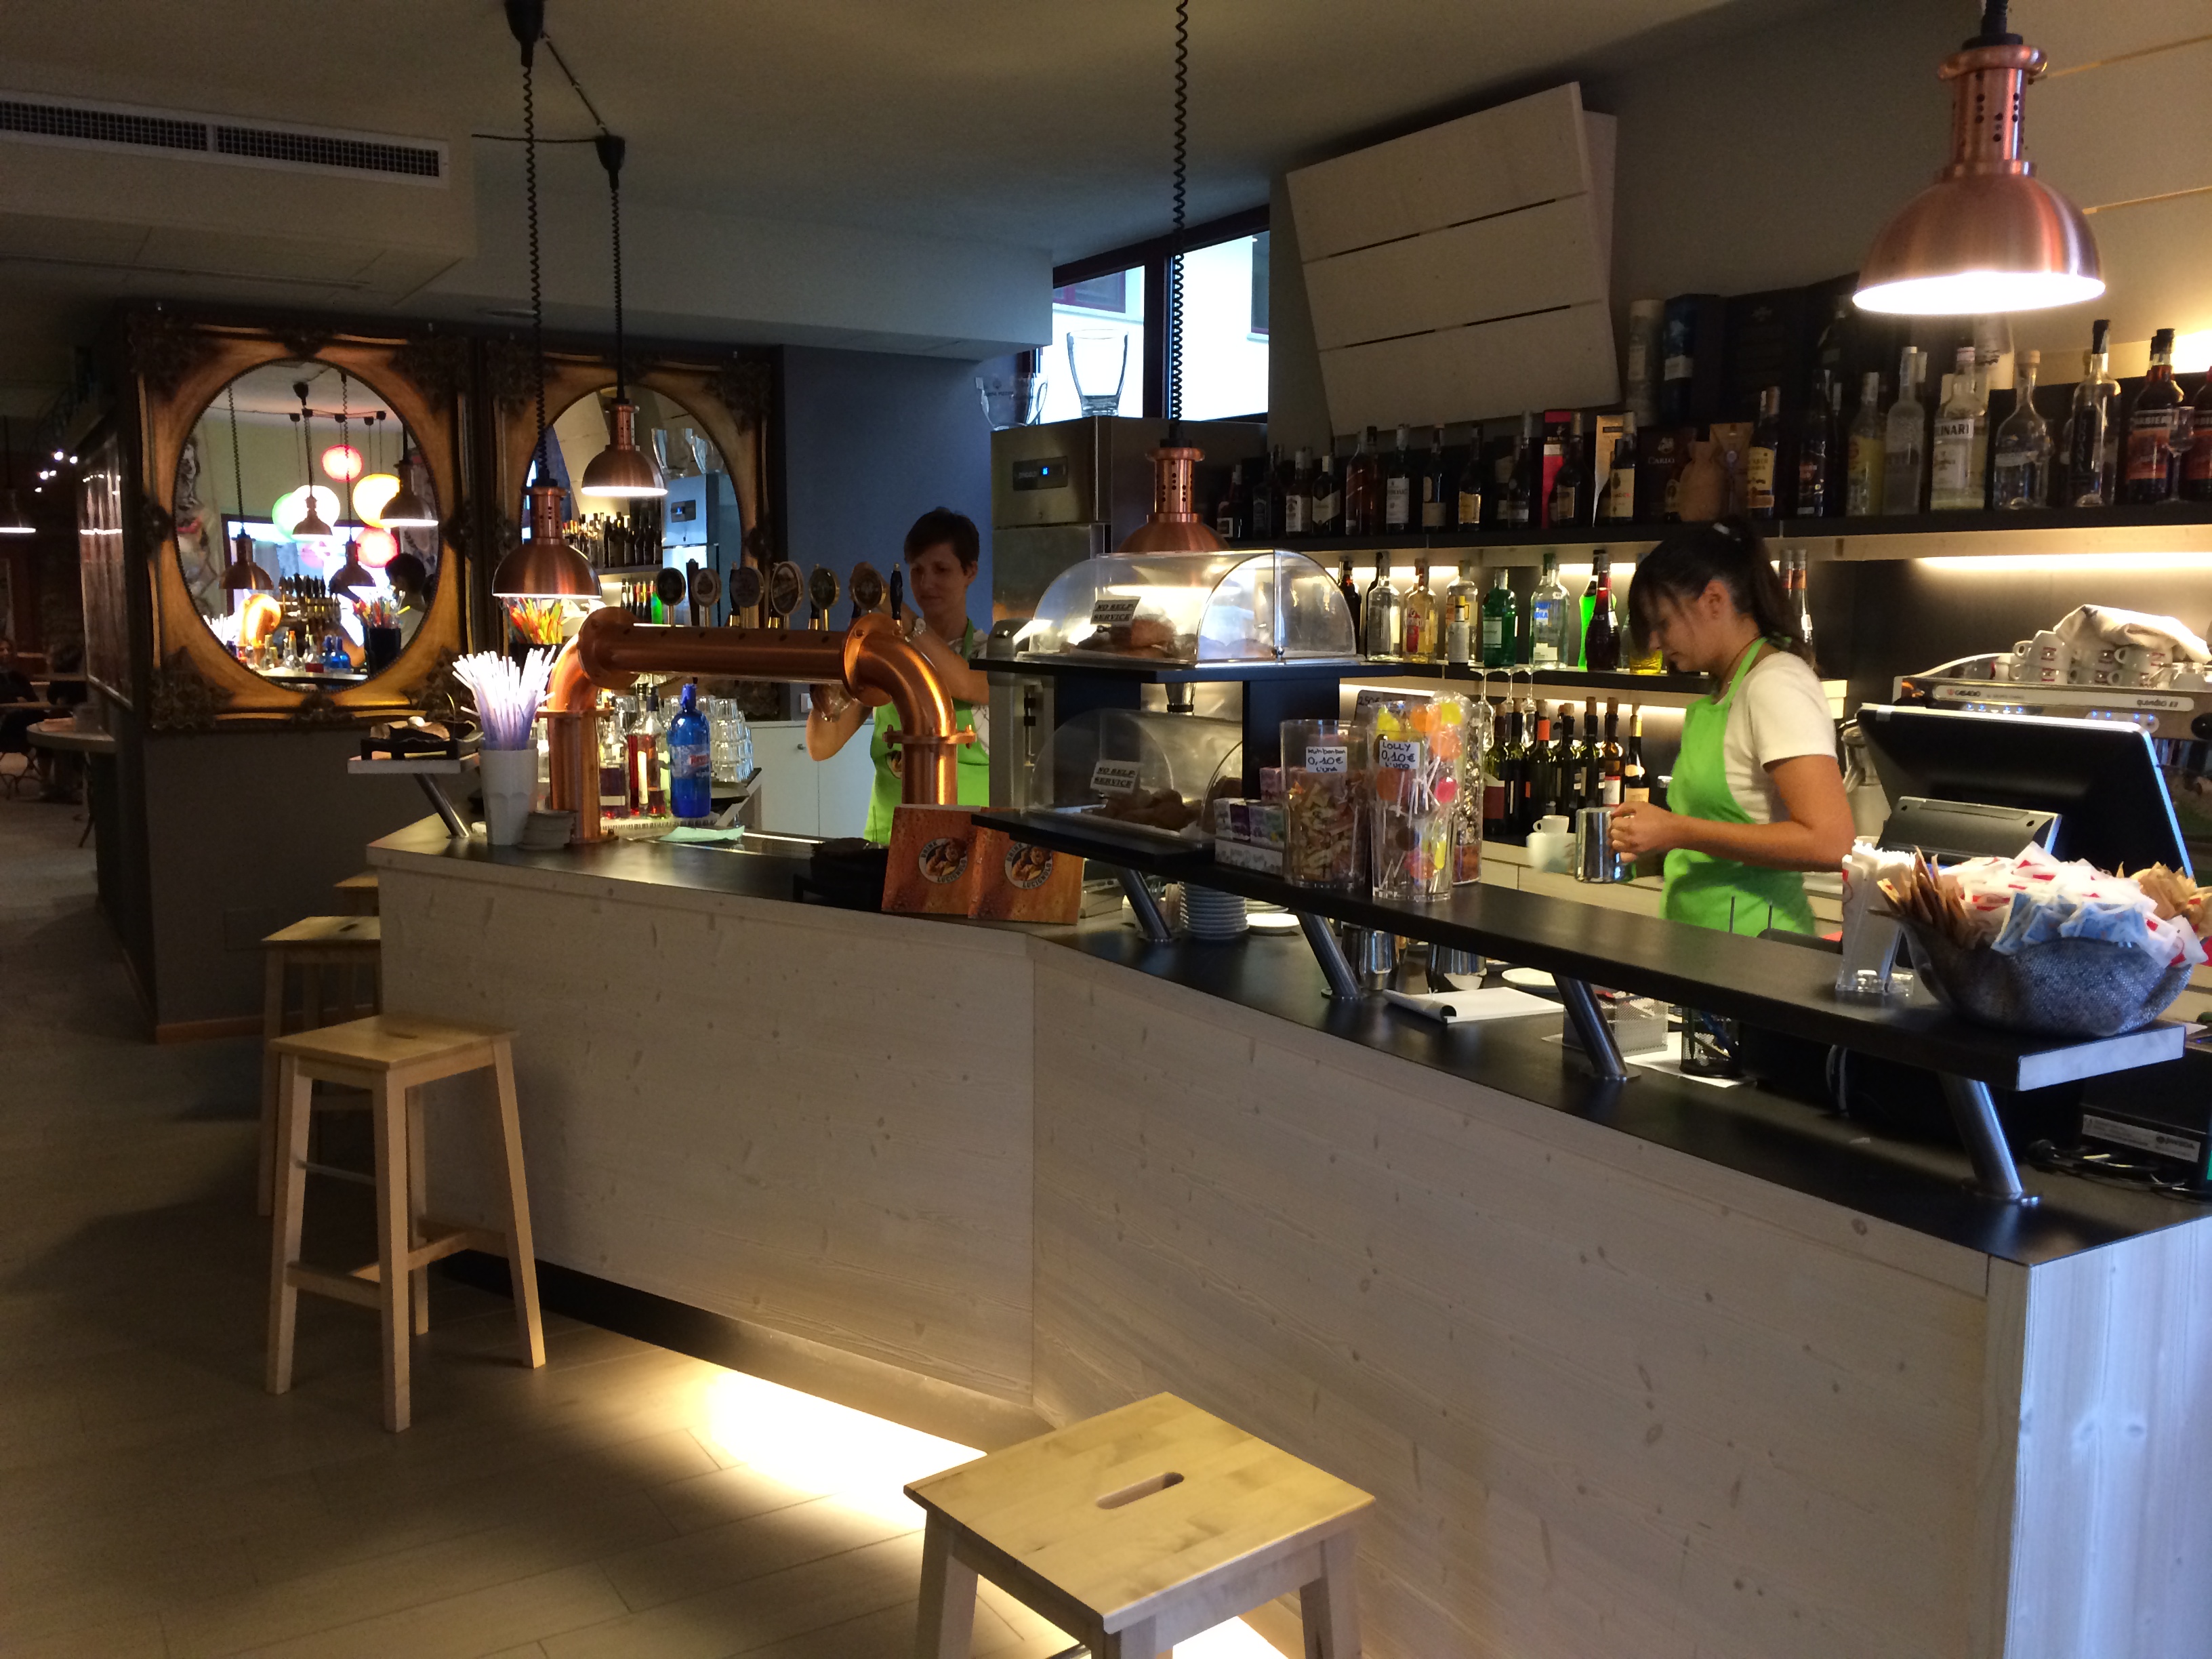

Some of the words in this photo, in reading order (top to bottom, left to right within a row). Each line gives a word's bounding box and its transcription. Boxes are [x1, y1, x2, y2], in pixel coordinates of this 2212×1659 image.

[1093, 613, 1131, 621] SERVICE
[1382, 741, 1410, 752] LOLLY
[1307, 756, 1343, 765] 0,10€
[1382, 750, 1416, 762] 0,10€
[1097, 766, 1110, 775] NO
[1094, 777, 1132, 788] SERVICE
[920, 840, 938, 858] DRINK
[1006, 842, 1023, 861] DRINK
[937, 859, 967, 883] LUCIGNOLO
[1022, 863, 1052, 888] LUCIGNOLO
